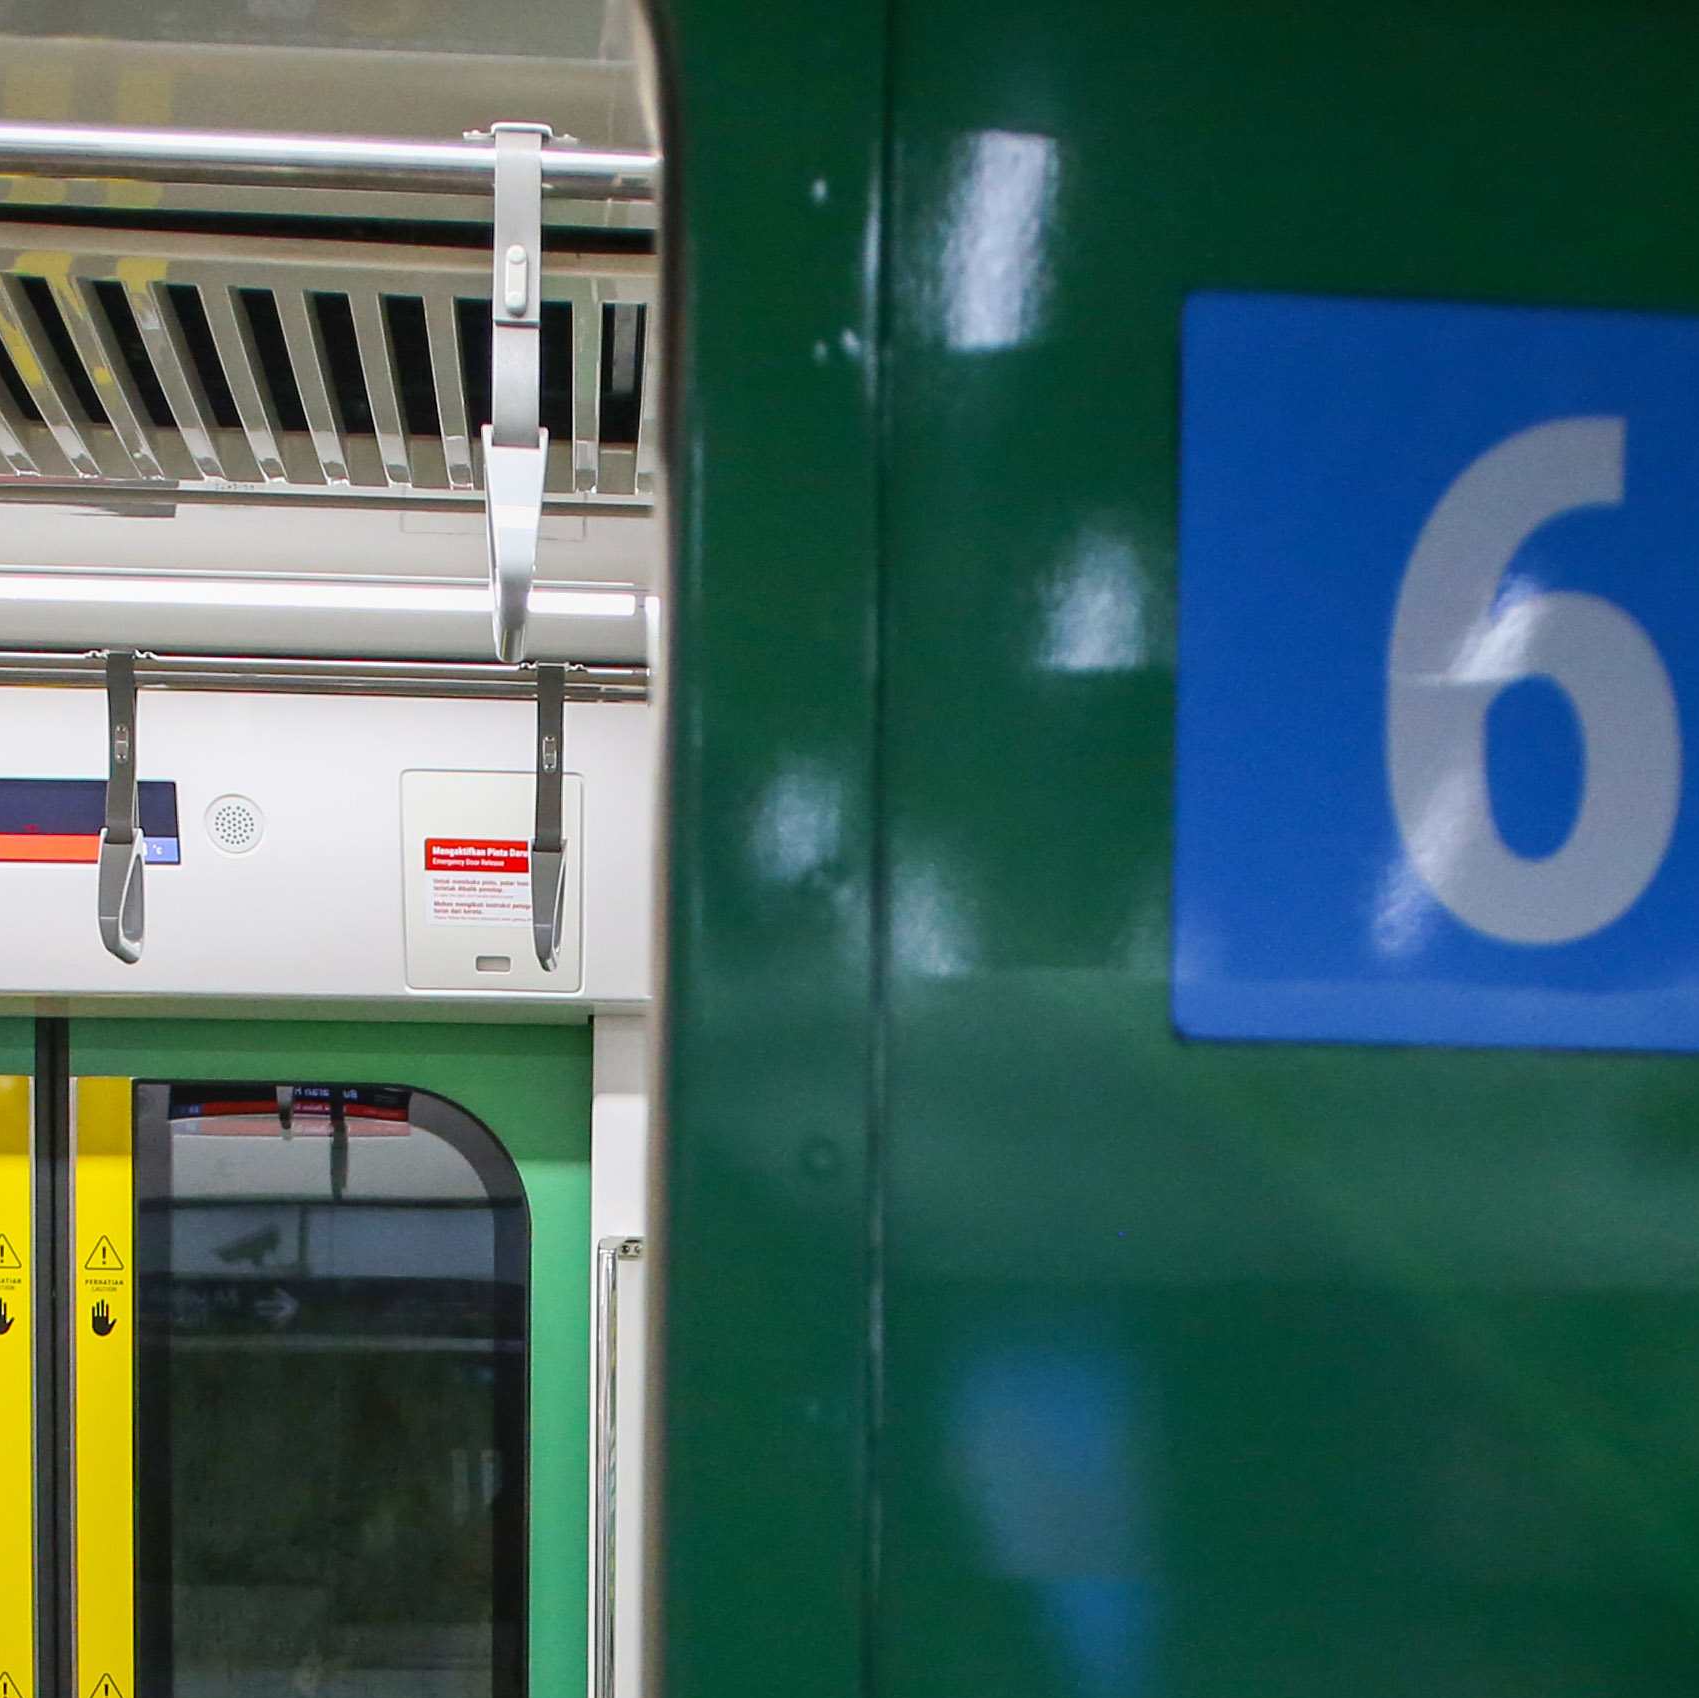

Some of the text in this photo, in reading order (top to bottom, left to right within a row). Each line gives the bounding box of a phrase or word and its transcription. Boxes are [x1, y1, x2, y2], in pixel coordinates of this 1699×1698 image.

[1386, 415, 1682, 946] 6
[432, 846, 486, 858] Mengaktifkan
[487, 847, 508, 857] Pintu
